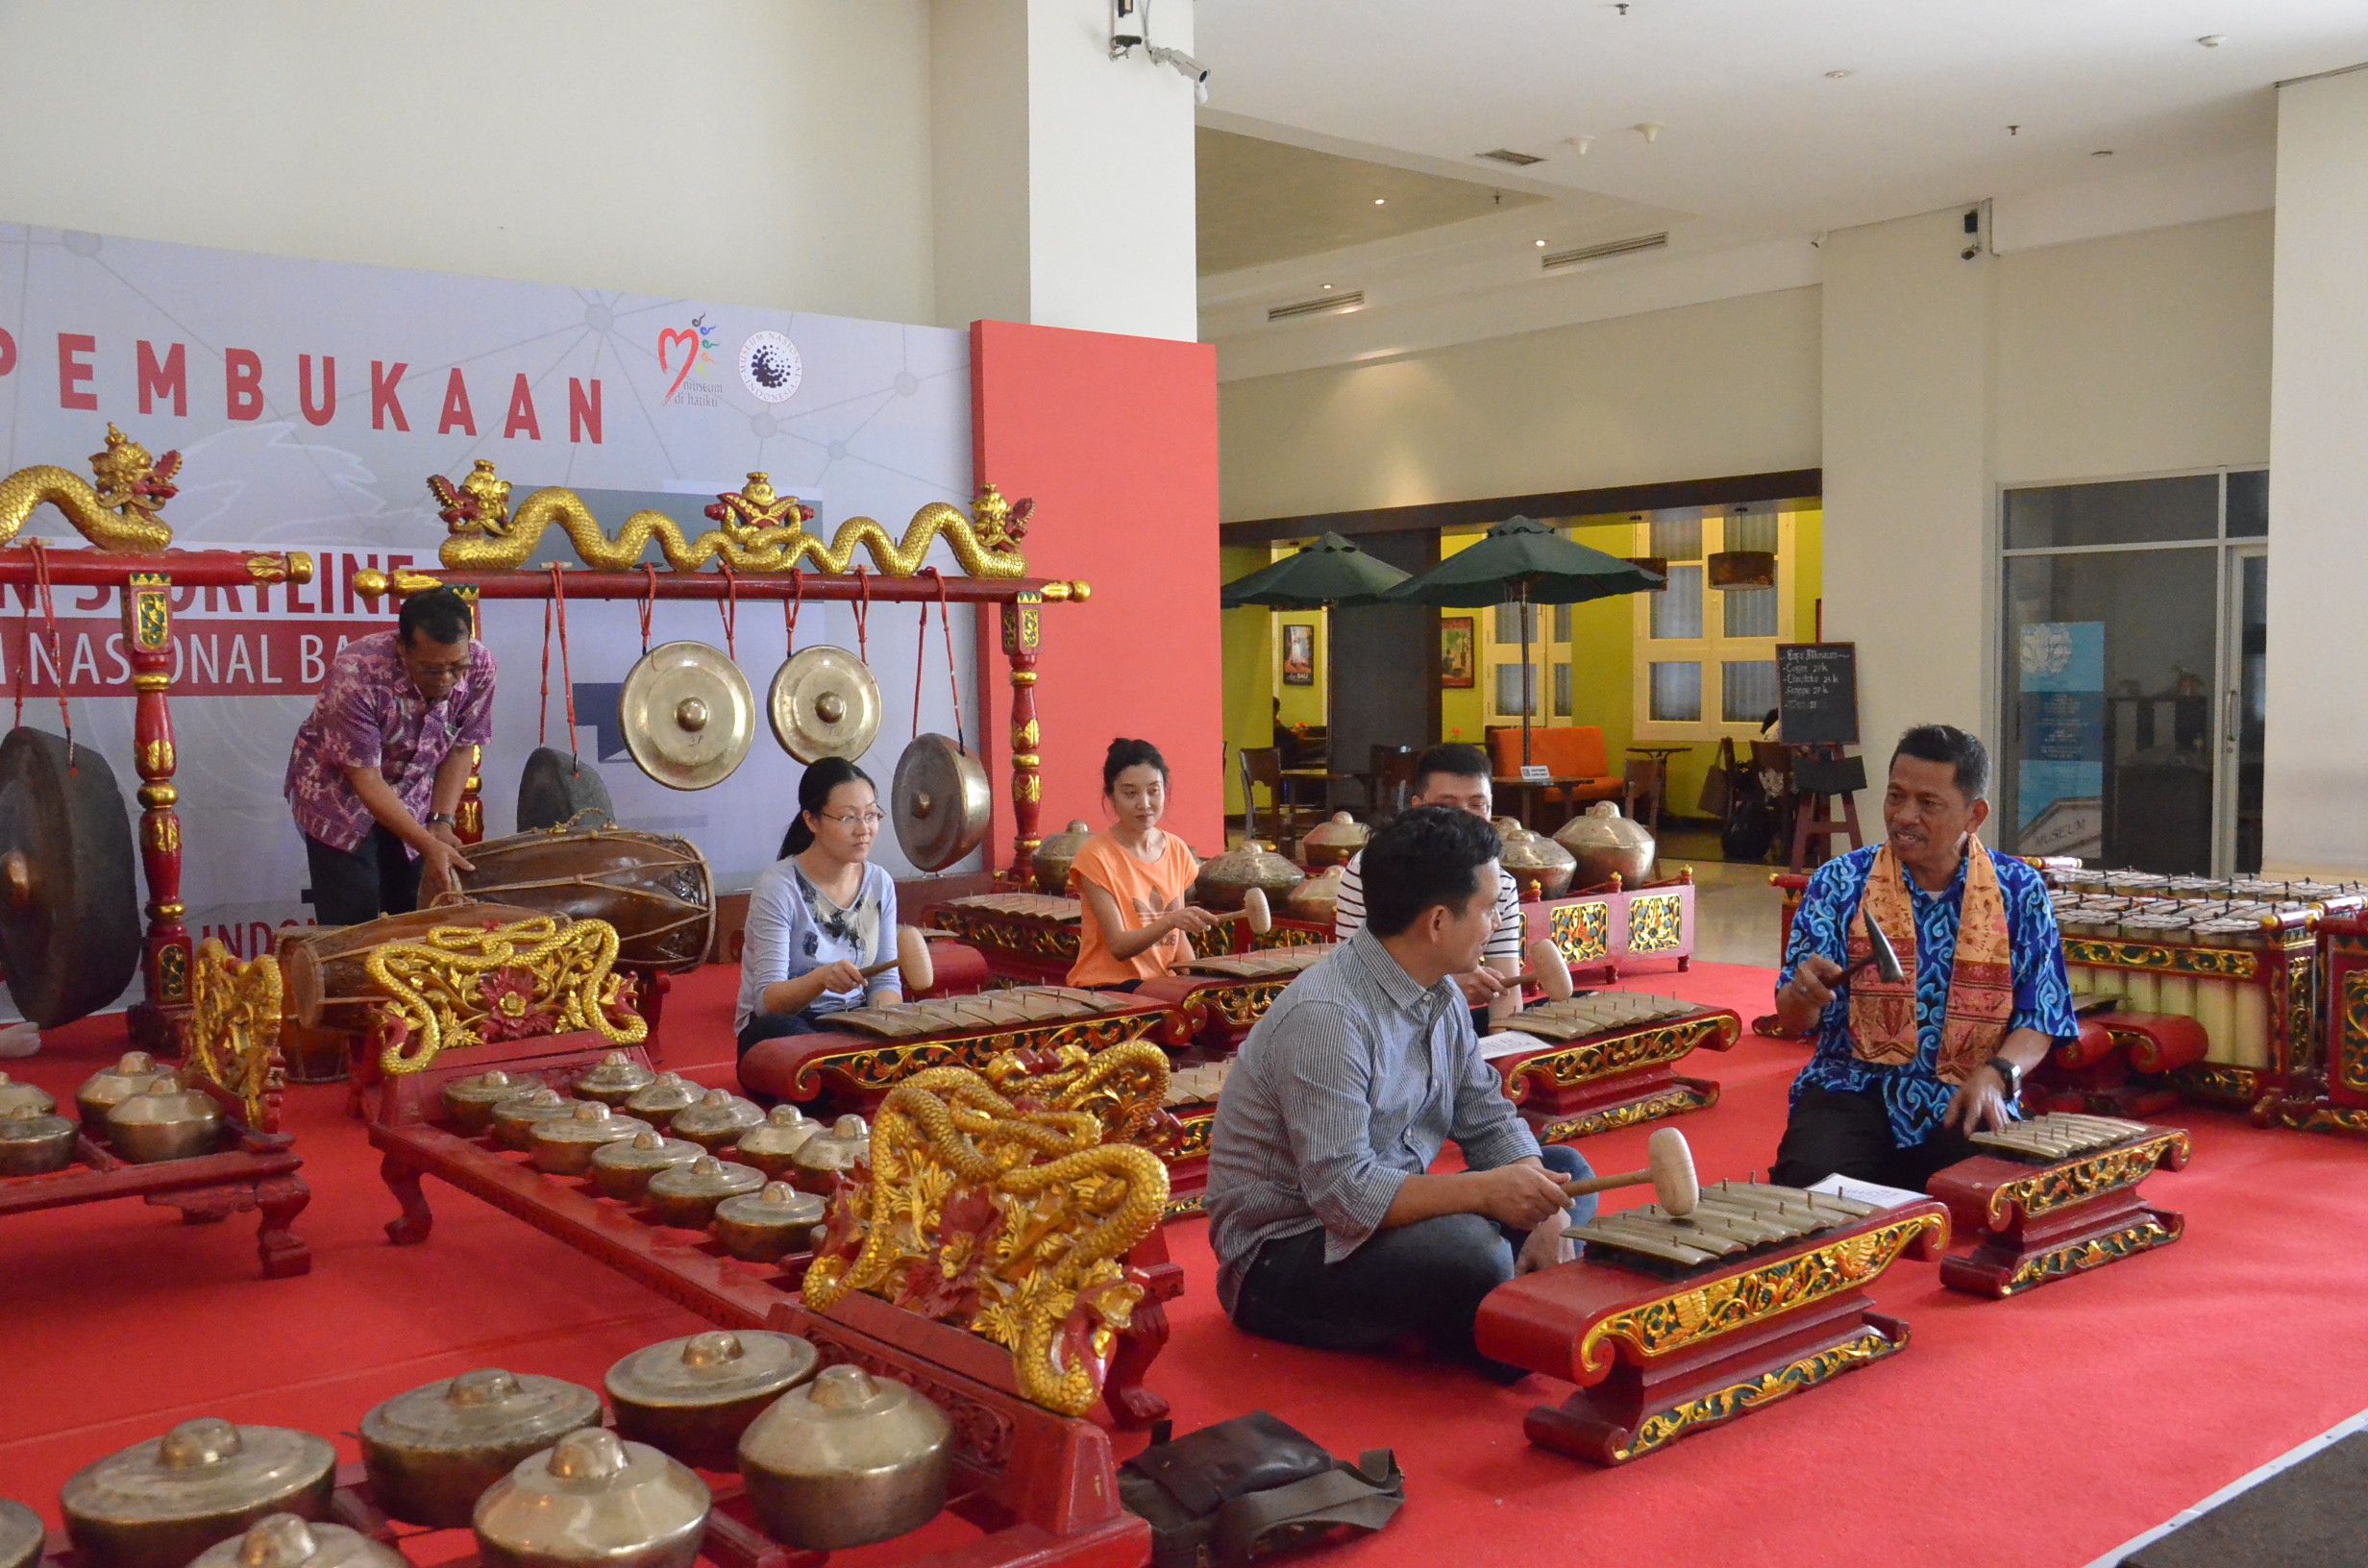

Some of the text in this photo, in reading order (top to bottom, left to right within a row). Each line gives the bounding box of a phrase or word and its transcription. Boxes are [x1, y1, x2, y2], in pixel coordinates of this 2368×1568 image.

[740, 332, 802, 380] MUSEUM NASIONAL
[683, 381, 723, 393] museum
[744, 379, 798, 402] INDONESIA
[674, 392, 718, 406] di hatiku
[30, 632, 283, 685] NASNAL
